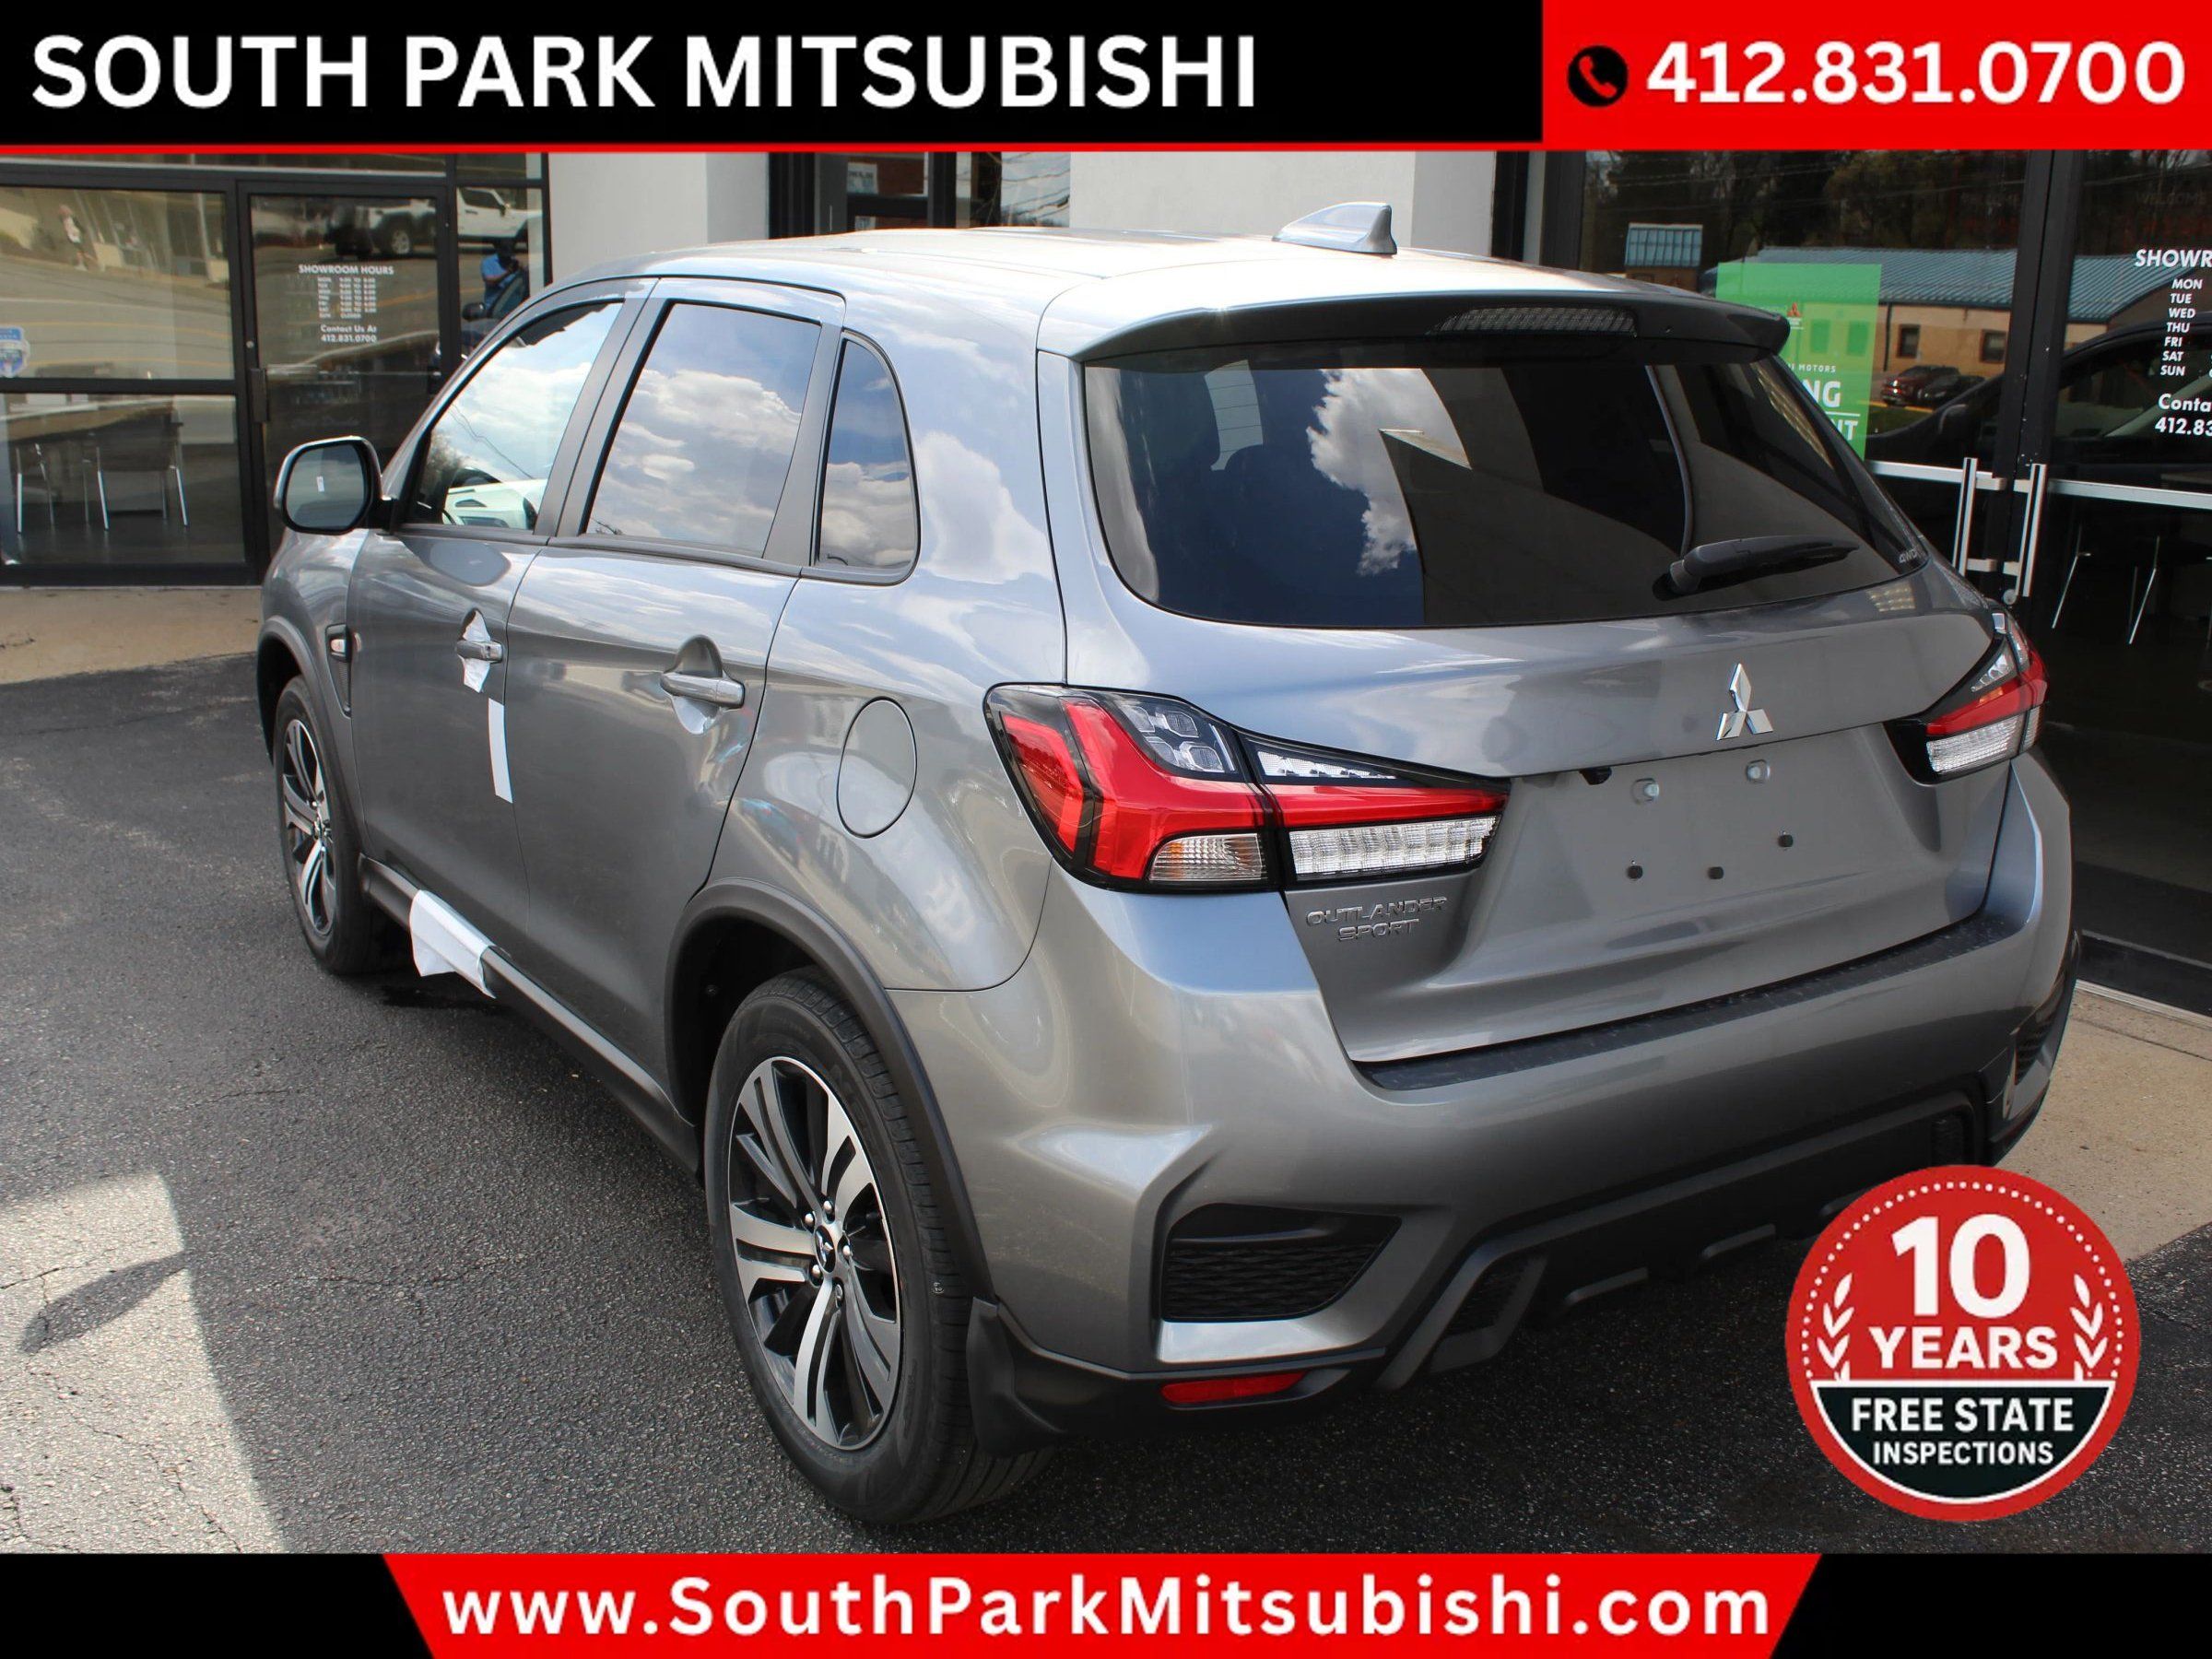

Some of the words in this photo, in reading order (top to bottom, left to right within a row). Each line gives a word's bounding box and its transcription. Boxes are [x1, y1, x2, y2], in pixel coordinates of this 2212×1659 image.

[298, 265, 359, 274] SHOWROOM
[360, 265, 394, 275] HOURS
[2171, 278, 2203, 289] MON
[2170, 292, 2193, 304] TUE
[2168, 307, 2196, 319] WED
[2166, 322, 2191, 334] THU
[2164, 335, 2183, 347] FRI
[2161, 350, 2184, 362] SAT
[1798, 363, 1836, 372] MOTORS
[2159, 364, 2186, 376] SUN
[1307, 896, 1447, 925] OUTLANDER
[1338, 918, 1419, 941] SPORT
